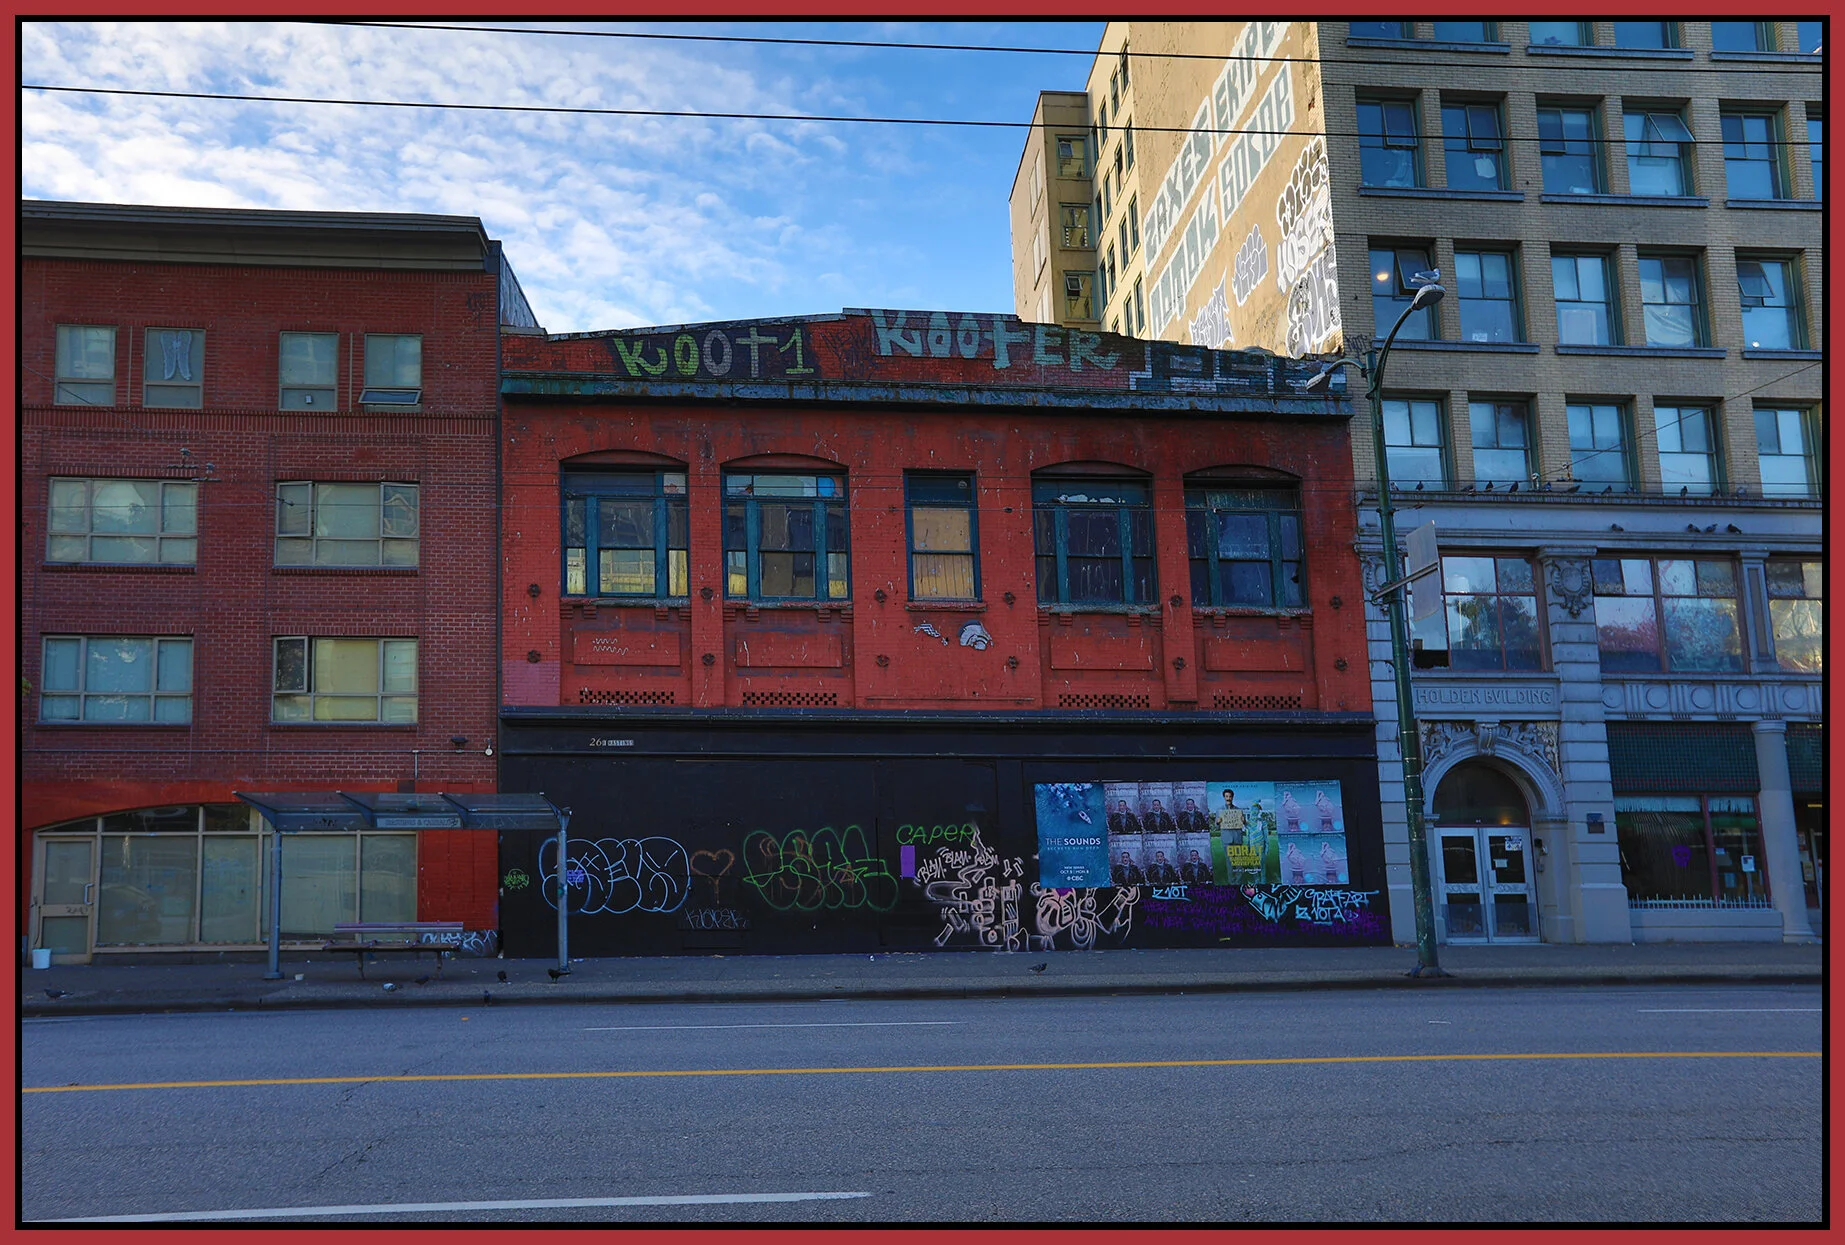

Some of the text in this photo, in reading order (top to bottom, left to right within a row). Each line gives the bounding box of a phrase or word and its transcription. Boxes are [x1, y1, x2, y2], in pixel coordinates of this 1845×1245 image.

[1416, 688, 1481, 705] HOLDEN
[1045, 837, 1063, 846] THE
[1063, 837, 1101, 846] SOUNDS
[1227, 845, 1263, 857] BORAT
